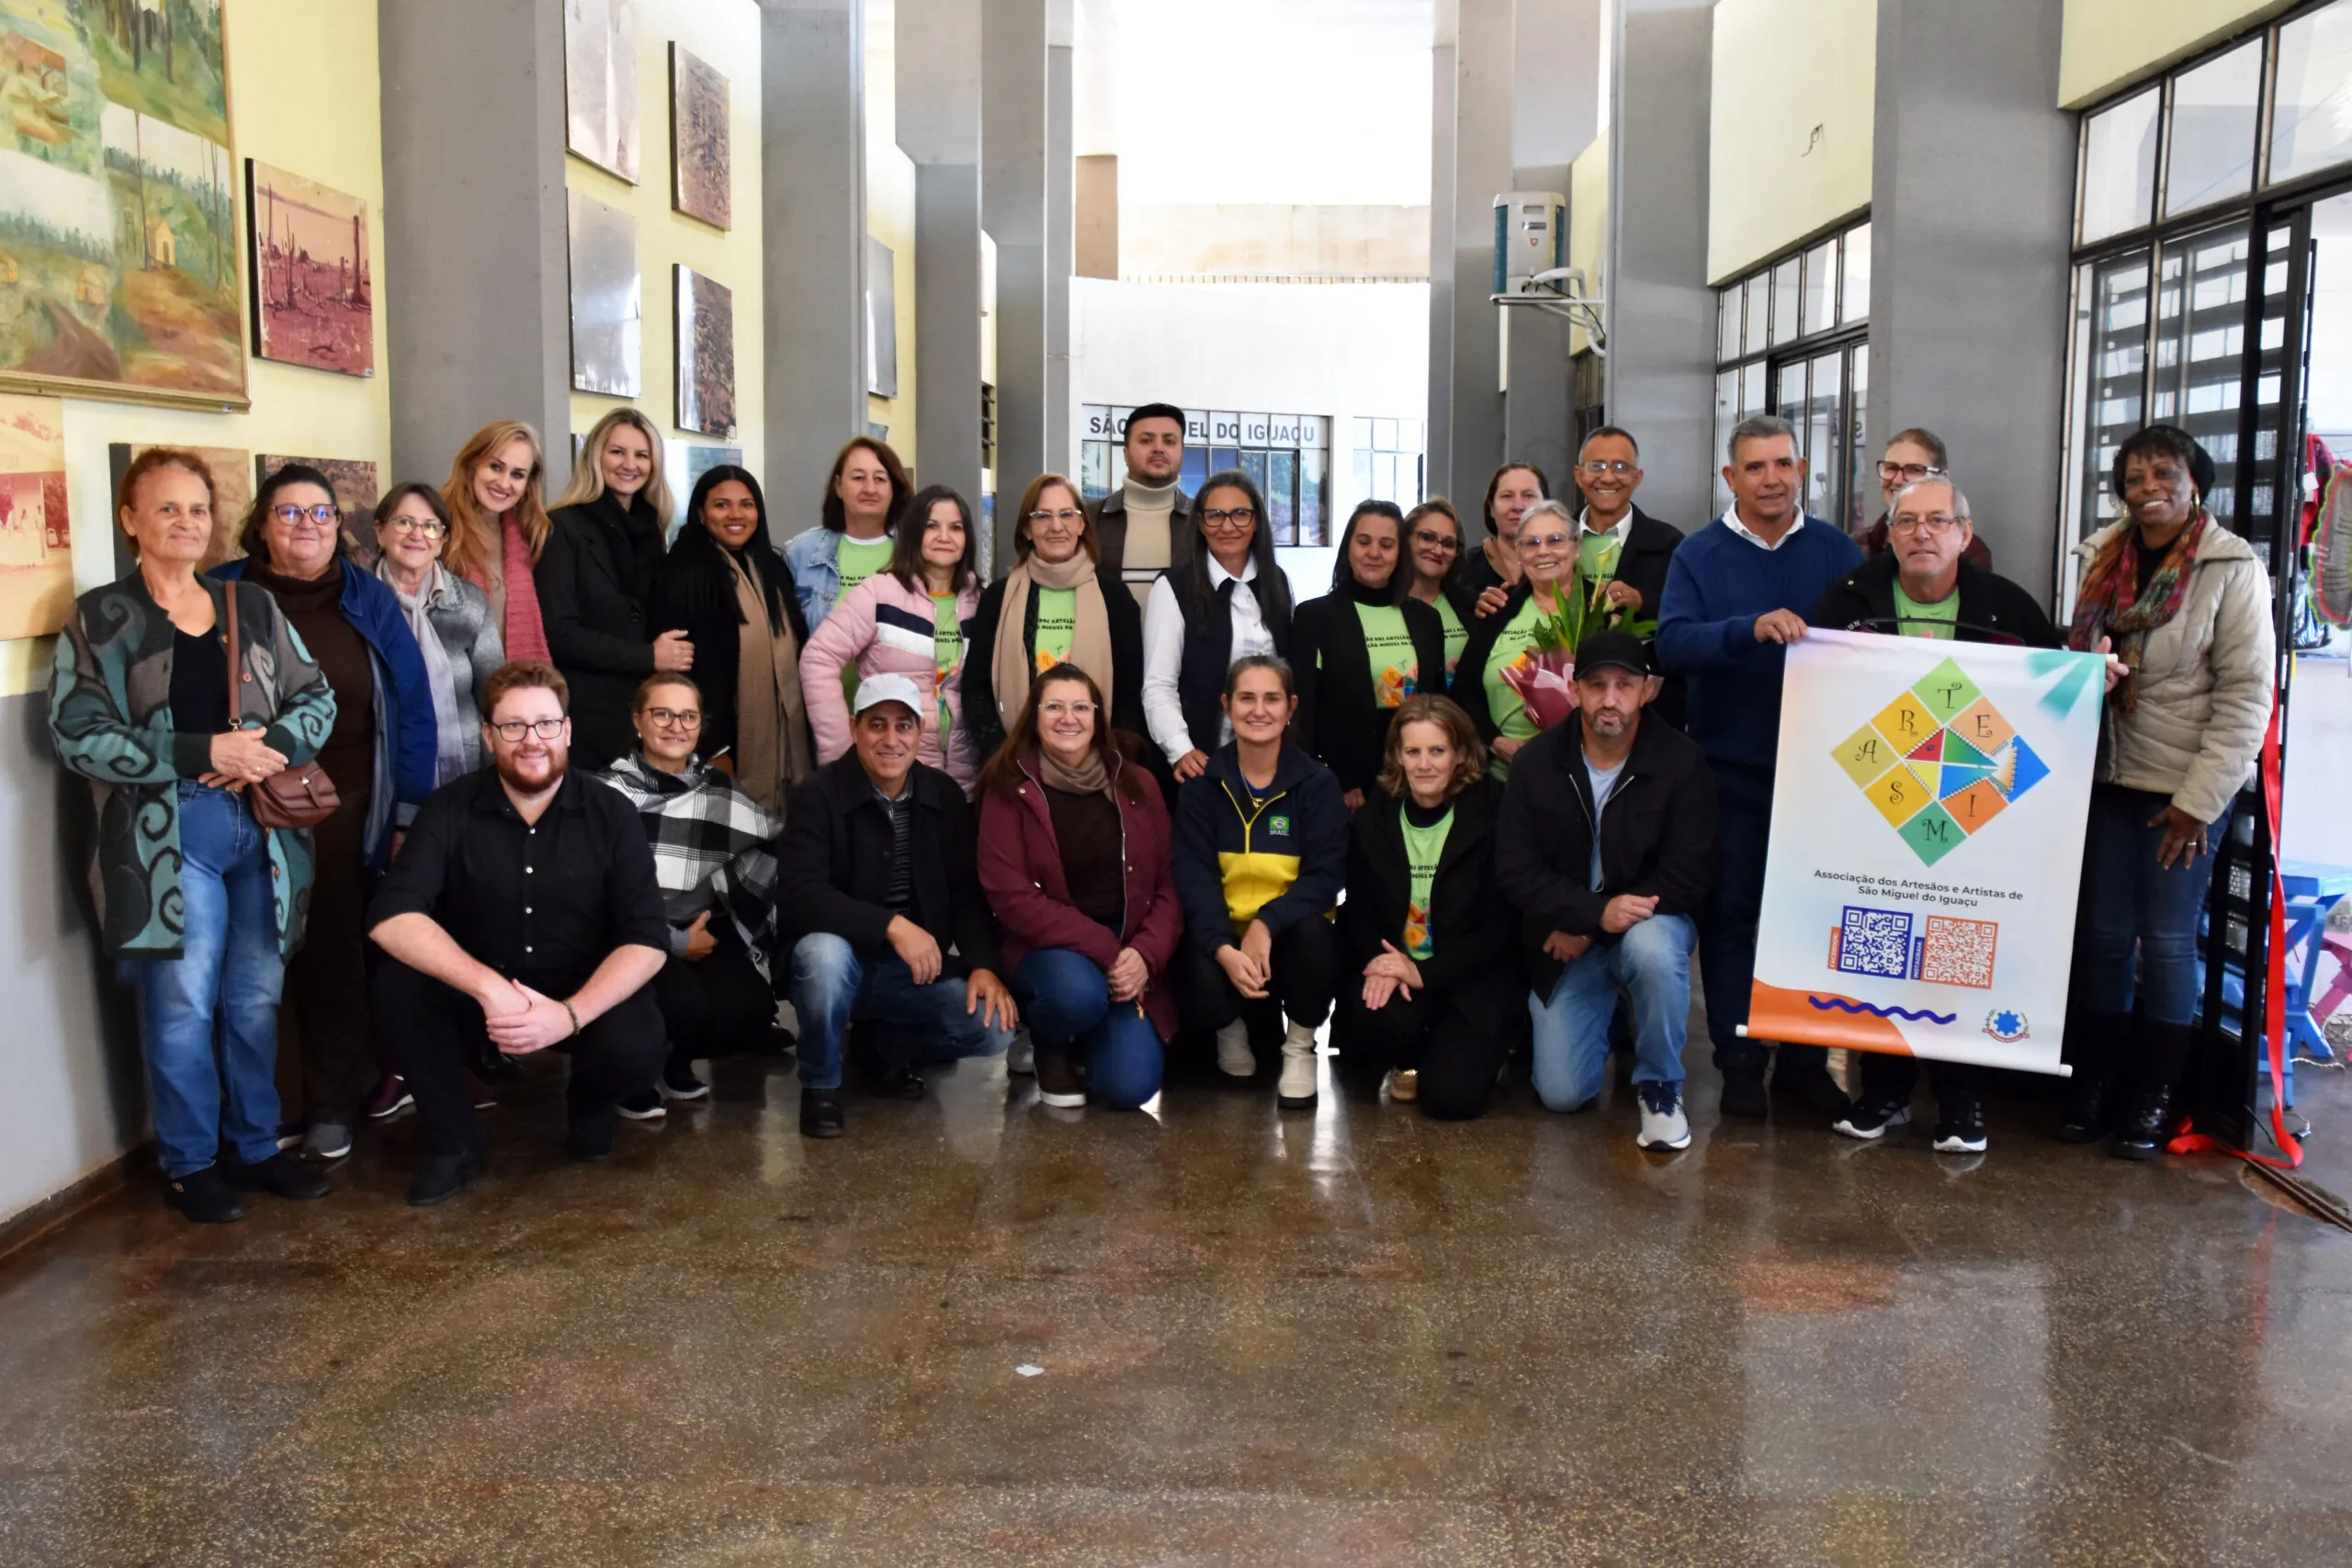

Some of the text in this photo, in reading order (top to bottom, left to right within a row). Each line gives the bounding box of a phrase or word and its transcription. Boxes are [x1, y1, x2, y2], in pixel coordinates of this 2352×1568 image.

[1216, 423, 1239, 439] DO
[1814, 869, 2023, 900] Associação dos Artesãos e Artistas de
[1858, 886, 1978, 908] São Miguel do Iguaçu
